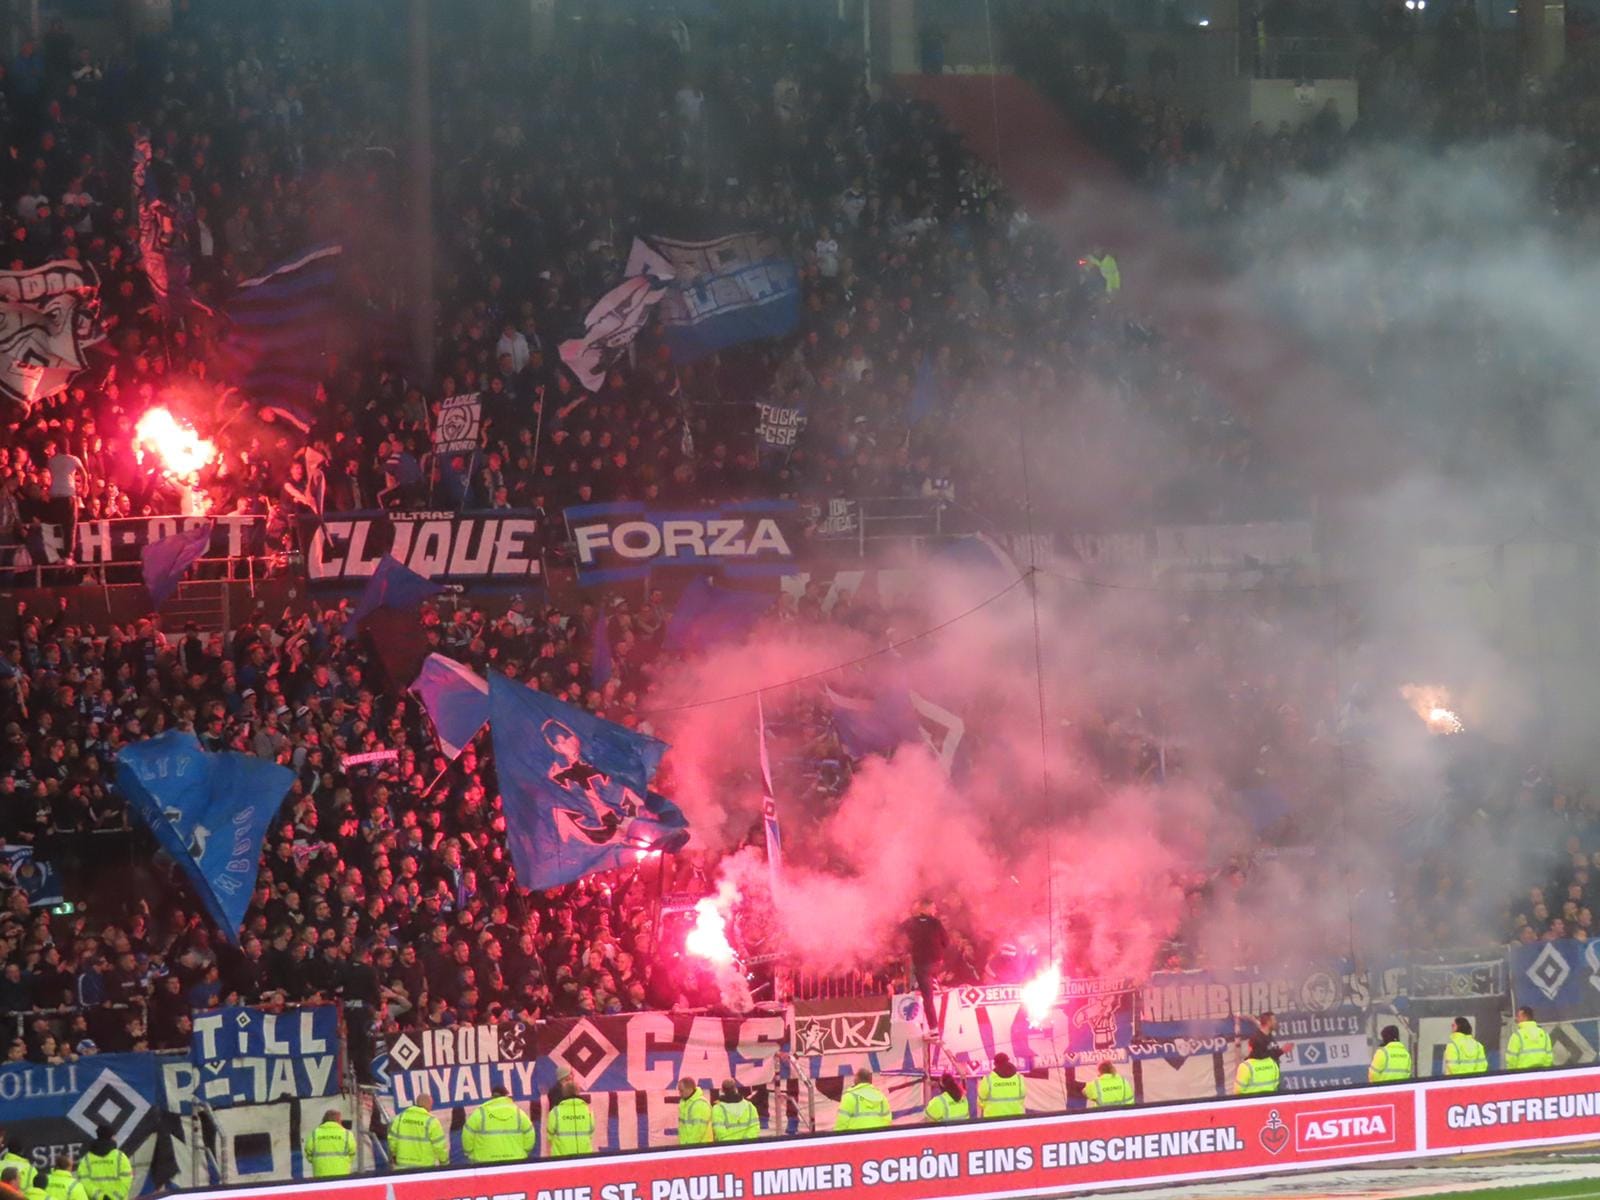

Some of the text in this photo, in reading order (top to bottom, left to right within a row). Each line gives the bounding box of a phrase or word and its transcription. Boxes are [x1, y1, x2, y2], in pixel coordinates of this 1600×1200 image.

[389, 510, 455, 521] ULTRAS
[574, 518, 792, 563] FORZA
[1272, 1013, 1360, 1036] amburg
[422, 1025, 499, 1067] IRON
[1305, 1115, 1387, 1142] ASTRA
[651, 1172, 743, 1200] PAULI:
[752, 1162, 853, 1196] IMMER
[861, 1150, 960, 1186] SCHÖN
[967, 1146, 1033, 1175] EINS
[1041, 1126, 1244, 1168] EINSCHENKEN.
